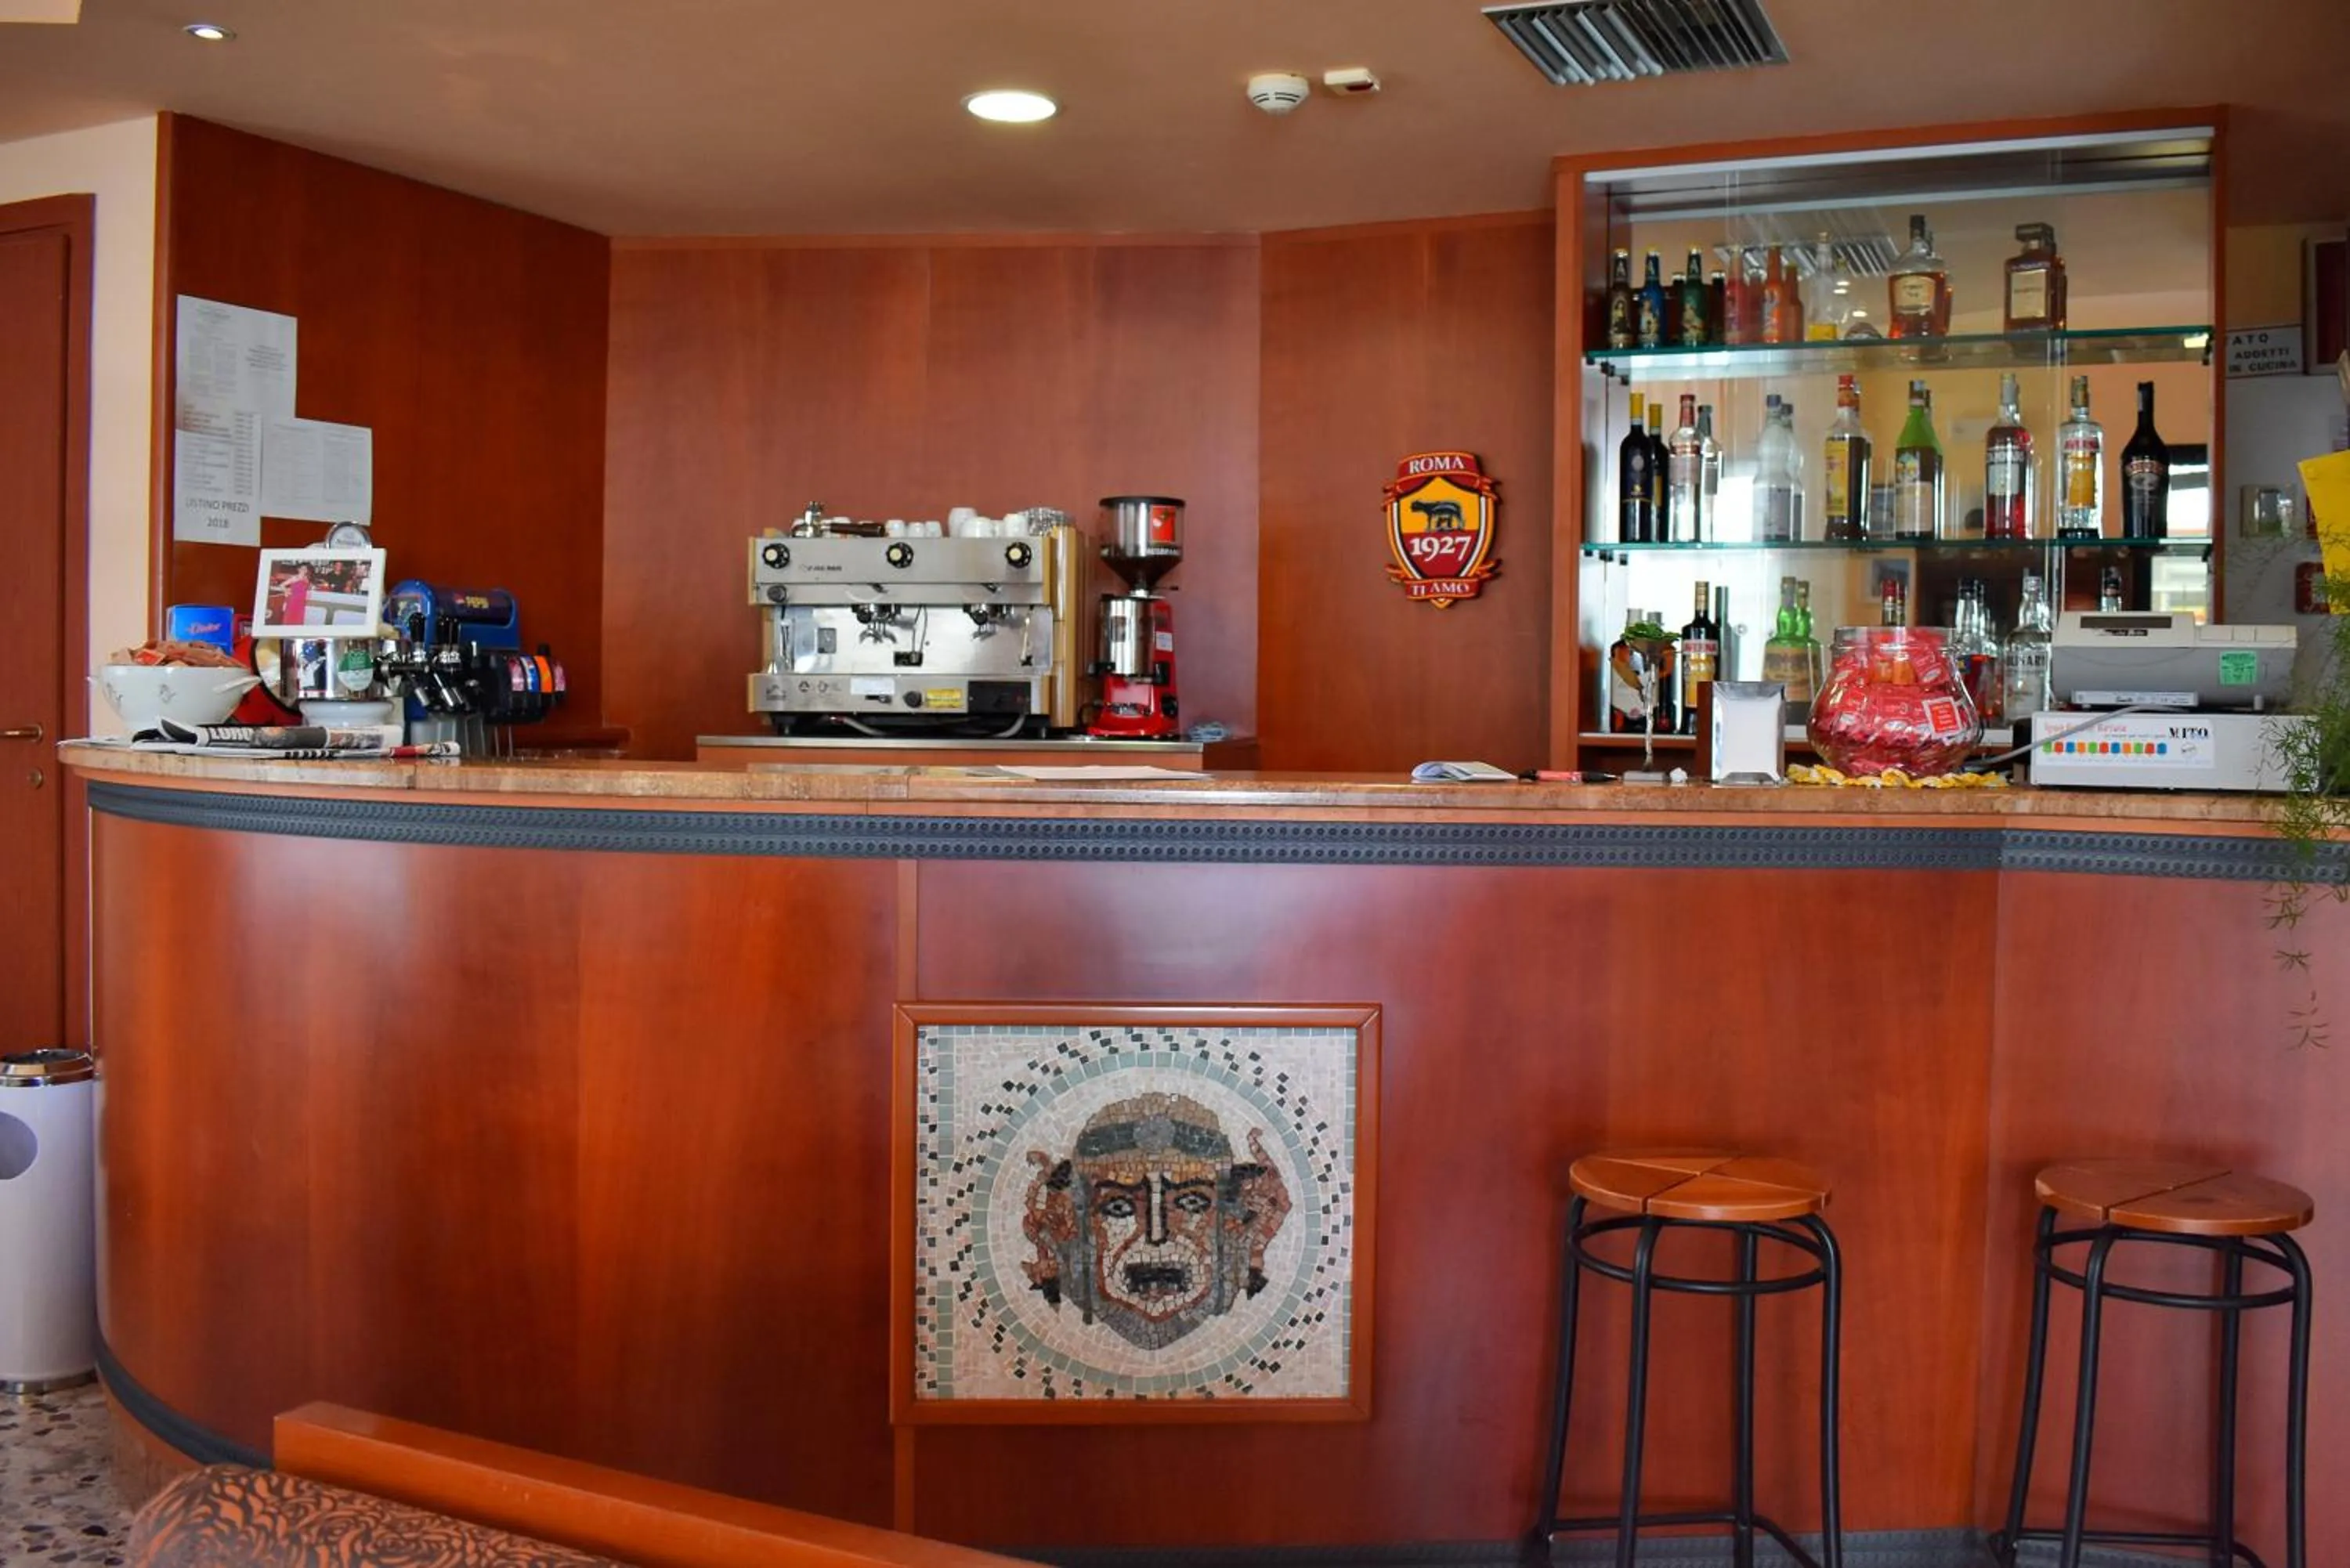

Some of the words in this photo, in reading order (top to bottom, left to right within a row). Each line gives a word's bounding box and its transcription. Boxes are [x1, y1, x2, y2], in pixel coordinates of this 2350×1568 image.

[2234, 347, 2290, 360] ADDETTI
[2247, 359, 2298, 372] CUCINA
[1409, 456, 1465, 474] ROMA
[1410, 535, 1472, 562] 1927
[1412, 584, 1426, 596] TI
[1430, 581, 1470, 594] AMO
[2168, 726, 2209, 739] MITO
